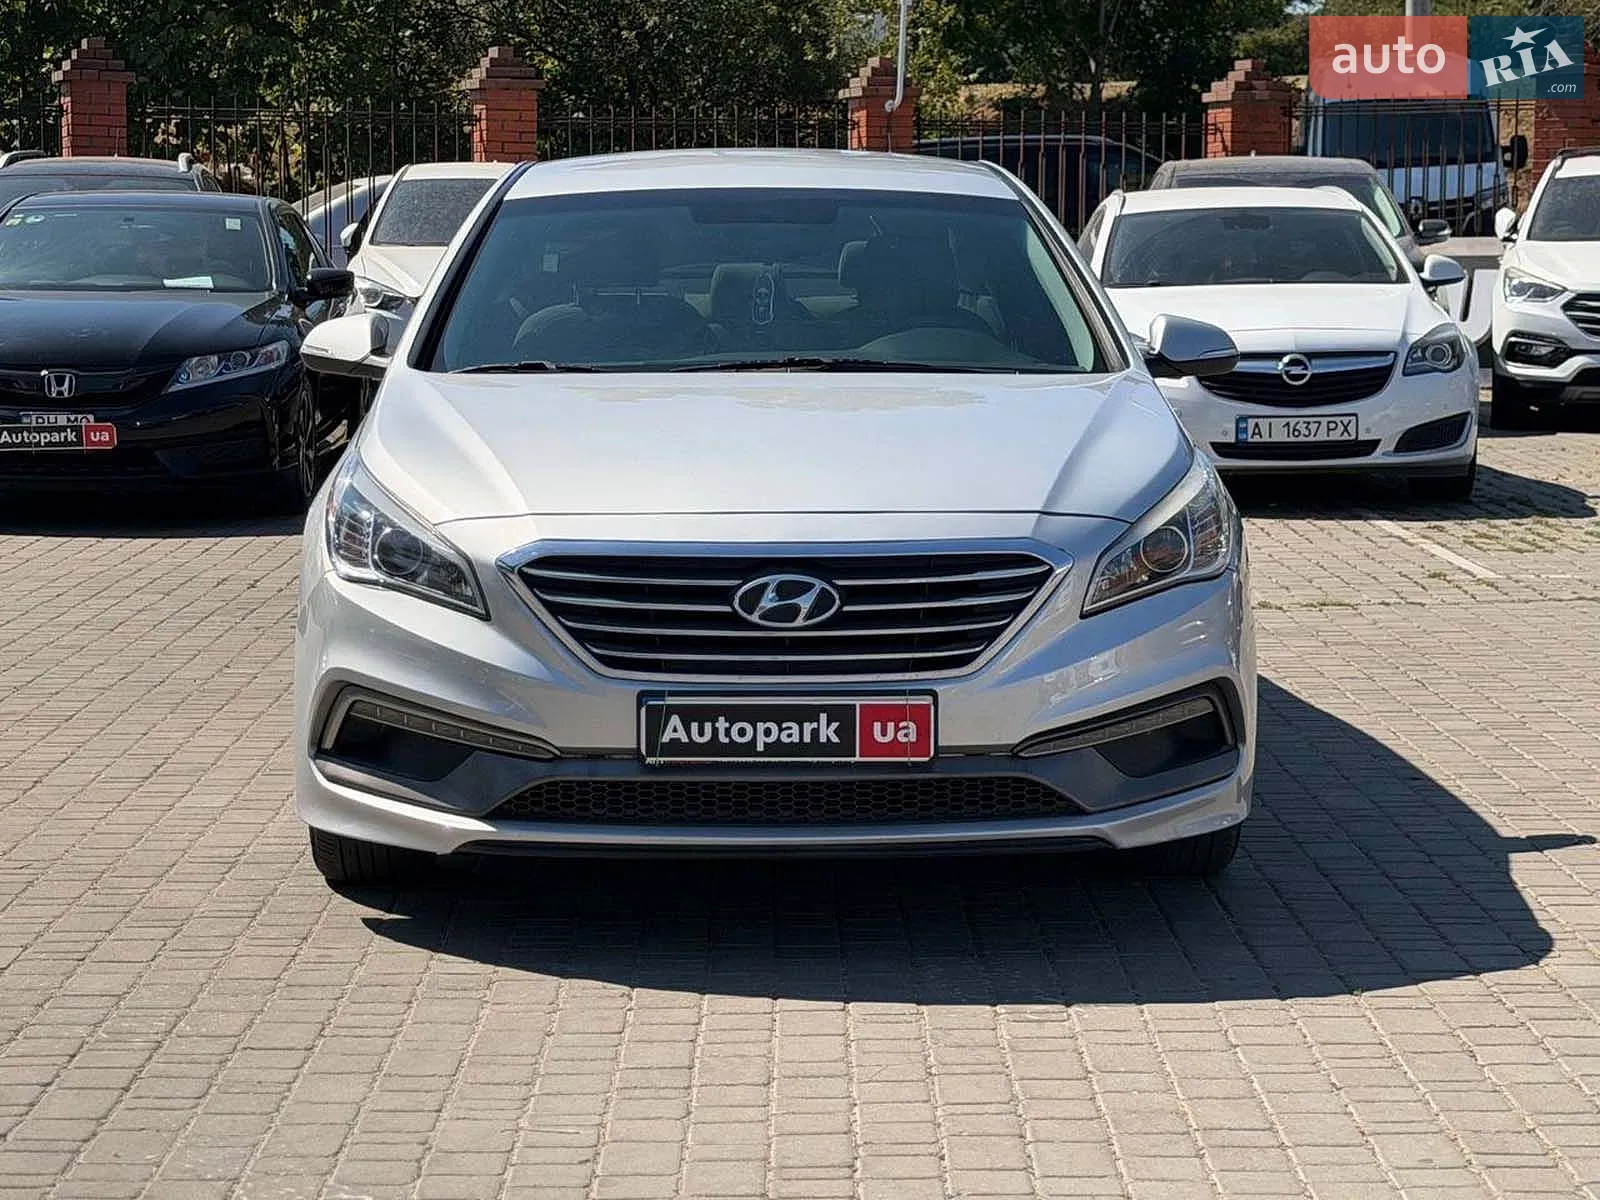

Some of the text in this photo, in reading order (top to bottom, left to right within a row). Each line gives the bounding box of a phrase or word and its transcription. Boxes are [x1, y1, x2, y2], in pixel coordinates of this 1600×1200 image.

[0, 428, 110, 446] Autopark ua
[1250, 422, 1273, 439] AI
[1282, 421, 1321, 438] 1637
[1326, 420, 1352, 438] PX
[661, 713, 918, 752] Autopark ua
